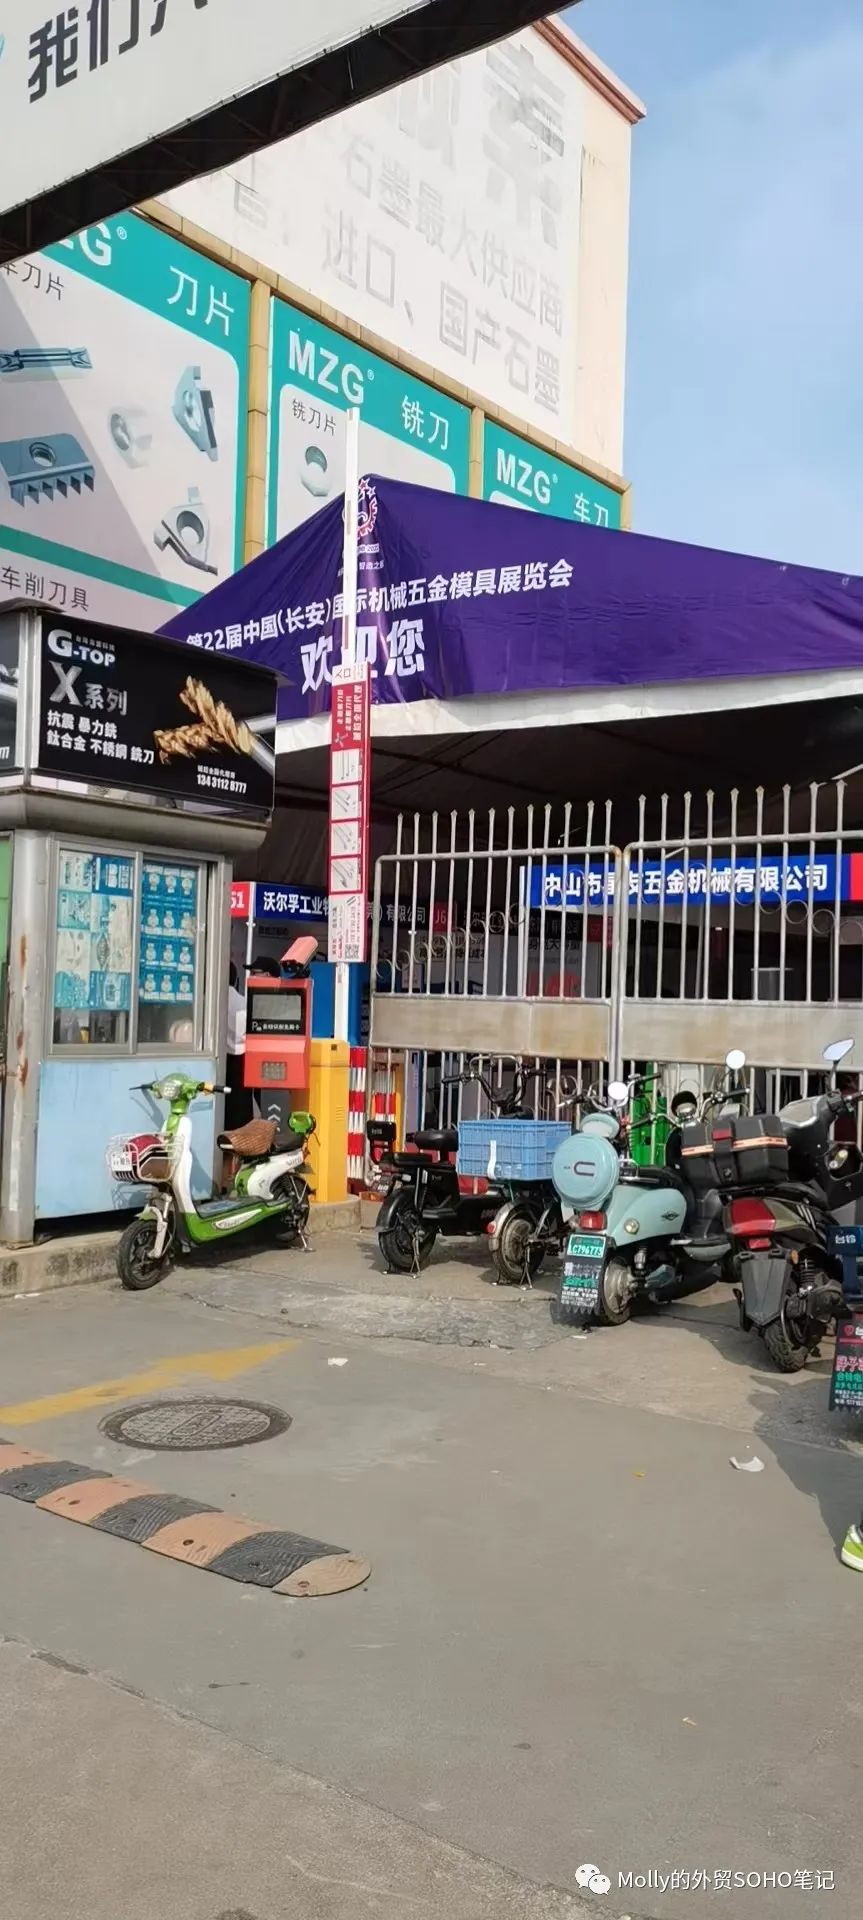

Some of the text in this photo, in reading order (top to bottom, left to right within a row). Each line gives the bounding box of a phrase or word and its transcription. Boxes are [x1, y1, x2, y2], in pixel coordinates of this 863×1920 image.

[28, 0, 208, 103] 我们
[166, 265, 235, 337] 刀片
[291, 397, 338, 437] 铣刀片
[401, 394, 450, 451] 铣刀
[0, 565, 89, 612] 车削刀具
[47, 628, 116, 667] G-TOP
[47, 709, 75, 730] 抗震
